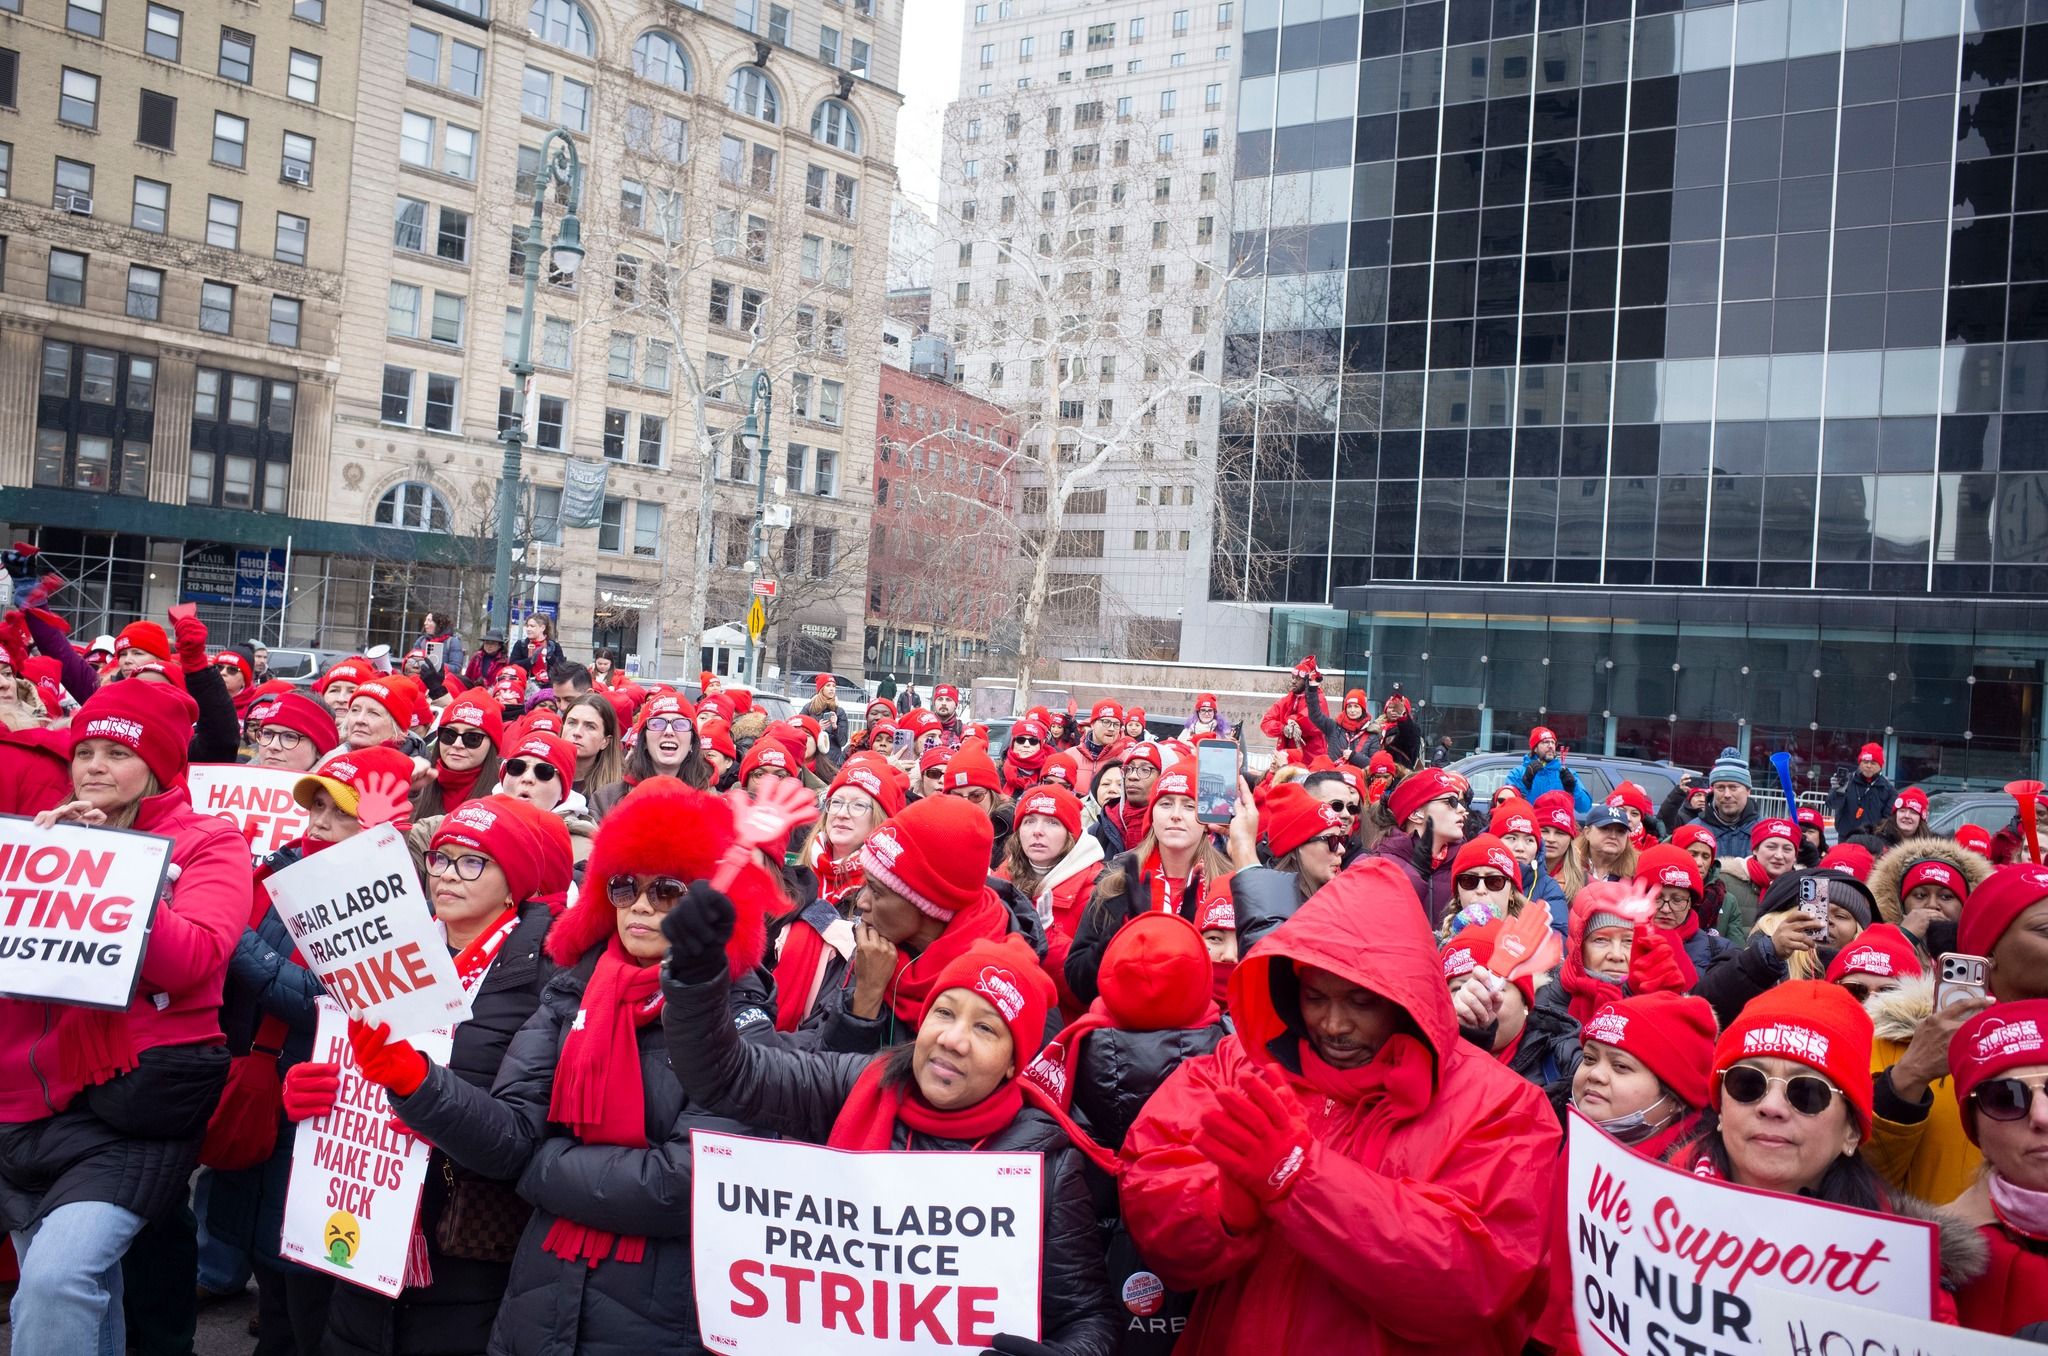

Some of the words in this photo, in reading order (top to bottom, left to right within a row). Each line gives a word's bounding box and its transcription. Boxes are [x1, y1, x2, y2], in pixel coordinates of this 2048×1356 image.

[199, 553, 225, 564] HAIR
[801, 624, 838, 634] FEDERAL
[85, 730, 139, 747] ASSOCIATION
[87, 719, 143, 740] NURSES
[287, 904, 332, 939] UNFAIR
[331, 873, 408, 922] LABOR
[309, 915, 393, 965] PRACTICE
[1744, 1028, 1829, 1058] NURSES
[1773, 1022, 1792, 1031] New
[1793, 1024, 1811, 1036] York
[1743, 1043, 1827, 1066] ASSOCIATION
[313, 1136, 374, 1182] MAKE
[373, 1154, 405, 1191] US
[997, 1166, 1032, 1176] NURSES
[326, 1176, 377, 1220] SICK
[717, 1181, 860, 1232] UNFAIR
[873, 1205, 1016, 1238] LABOR
[765, 1225, 960, 1277] PRACTICE
[1587, 1162, 1633, 1235] We
[1642, 1196, 1890, 1296] Support
[1126, 1284, 1162, 1299] DISGUSTING
[1578, 1212, 1619, 1279] NY
[1633, 1254, 1758, 1344] NUR
[728, 1258, 999, 1348] STRIKE
[1584, 1273, 1630, 1347] ON
